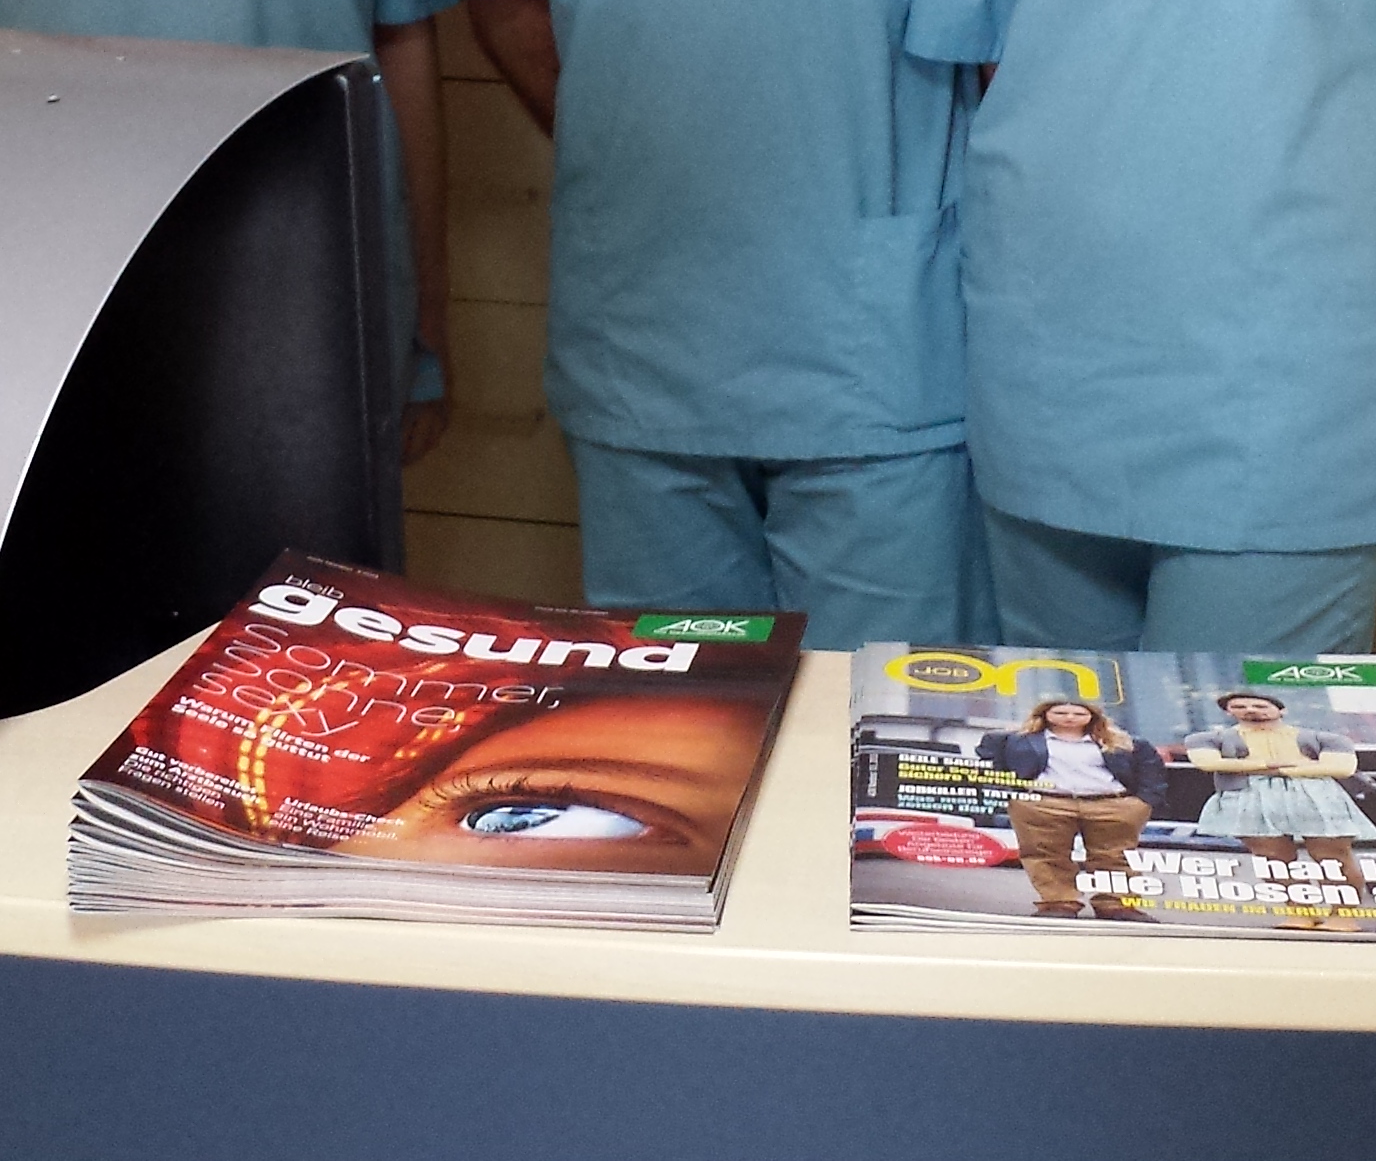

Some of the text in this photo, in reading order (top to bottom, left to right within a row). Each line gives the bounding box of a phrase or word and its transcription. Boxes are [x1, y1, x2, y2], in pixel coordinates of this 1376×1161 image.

[285, 574, 344, 600] bleib
[248, 584, 700, 673] gesund
[653, 619, 749, 634] AOK
[913, 666, 970, 678] JOB
[1267, 666, 1363, 682] AOK
[171, 703, 228, 729] Seele
[232, 726, 257, 739] so
[179, 696, 255, 729] Warum
[333, 748, 371, 763] der
[175, 786, 225, 809] stellen
[898, 784, 1042, 801] JOBKILLER TATTOO
[274, 812, 298, 824] ein
[269, 819, 303, 832] eine
[306, 827, 350, 841] Reise
[1123, 849, 1241, 877] Wer
[1252, 855, 1347, 882] hat
[1075, 870, 1165, 896] die
[1179, 875, 1361, 906] Hosen
